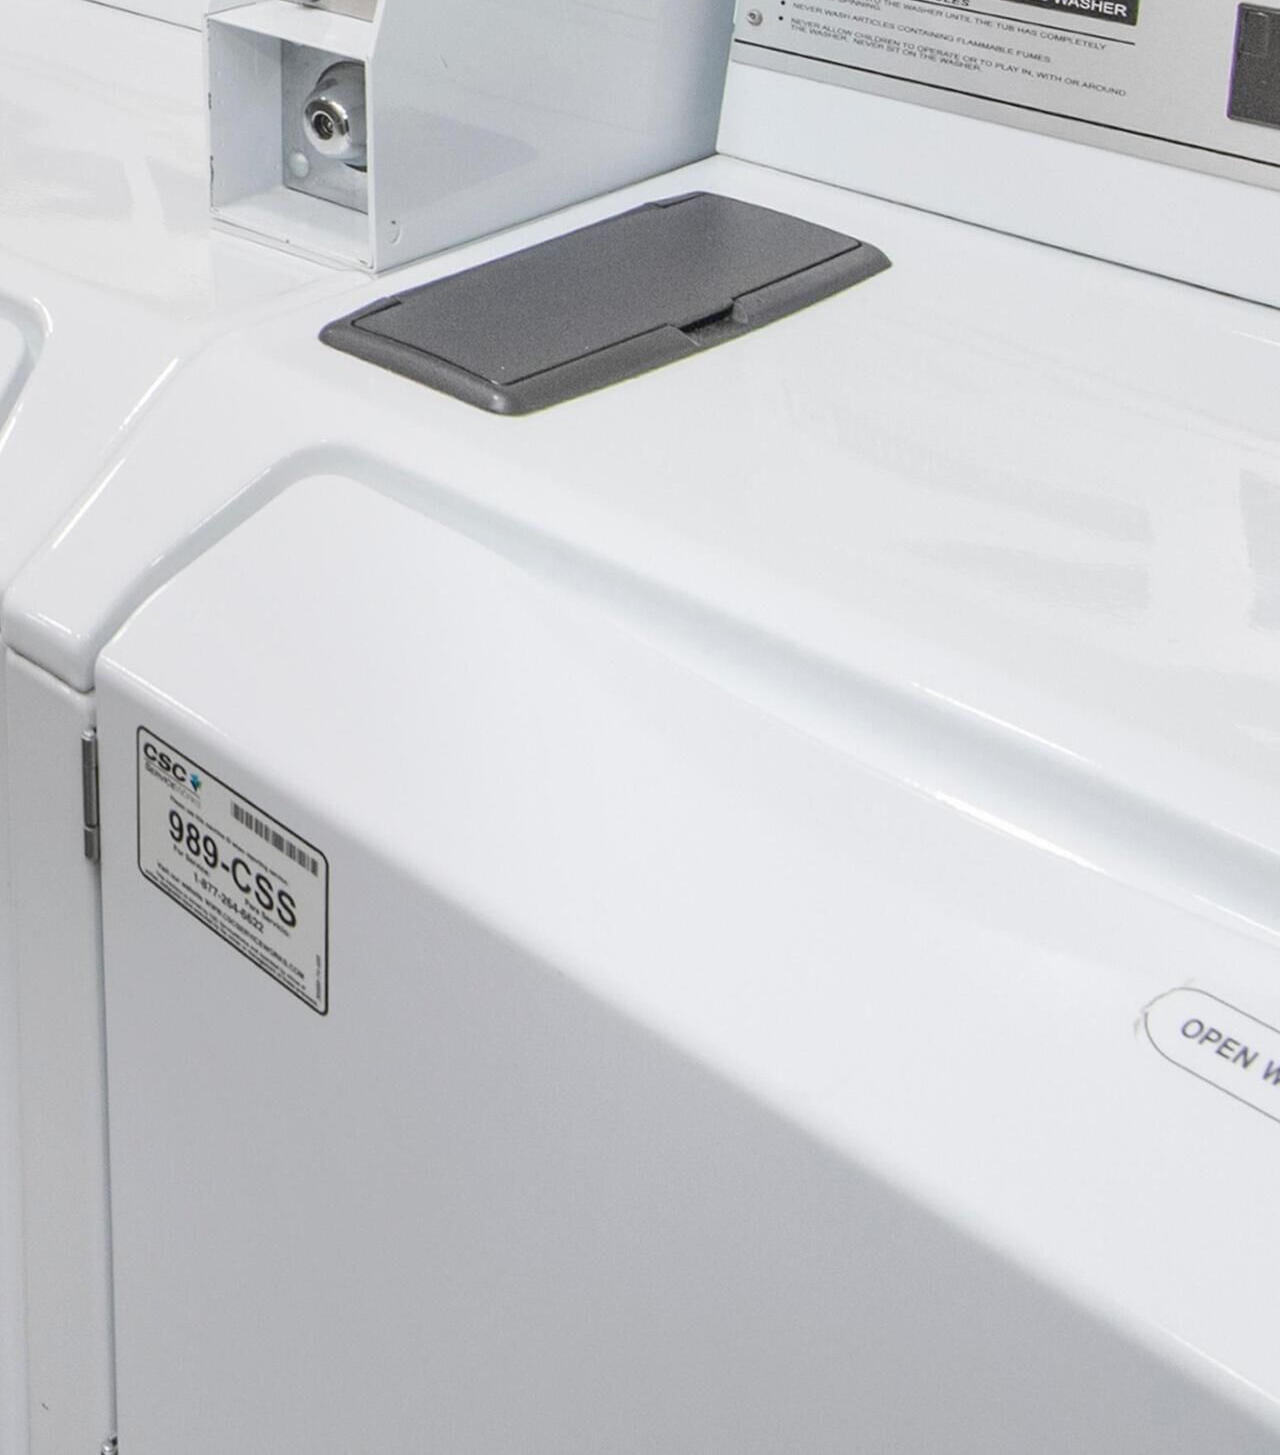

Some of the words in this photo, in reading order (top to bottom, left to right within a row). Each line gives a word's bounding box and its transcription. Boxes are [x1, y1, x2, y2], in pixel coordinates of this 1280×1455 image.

[791, 24, 807, 34] THE
[853, 37, 885, 50] NEVER
[885, 43, 901, 54] SIT
[902, 47, 917, 58] ON
[919, 52, 938, 63] THE
[793, 2, 823, 14] NEVER
[824, 8, 850, 19] WASH
[853, 14, 895, 30] ARTICLES
[897, 24, 955, 43] CONTAINING
[956, 37, 1014, 55] FLAMMABLE
[884, 0, 900, 9] THE
[903, 4, 943, 17] WASHER
[945, 12, 972, 24] UNTIL
[974, 17, 993, 27] THE
[996, 22, 1015, 32] TUB
[1017, 27, 1038, 37] HAS
[1040, 31, 1107, 50] COMPLETELY
[791, 18, 821, 29] NEVER
[823, 25, 853, 36] ALLOW
[854, 31, 901, 47] CHILDREN
[903, 42, 916, 50] TO
[917, 45, 960, 60] OPERATE
[962, 54, 978, 64] OR
[980, 58, 993, 67] TO
[995, 62, 1019, 73] PLAY
[1037, 71, 1062, 82] WITH
[1064, 77, 1080, 86] OR
[1081, 81, 1127, 98] AROUND
[143, 742, 187, 782] CSC
[169, 809, 297, 929] 989-CSS
[1180, 1017, 1259, 1069] OPEN
